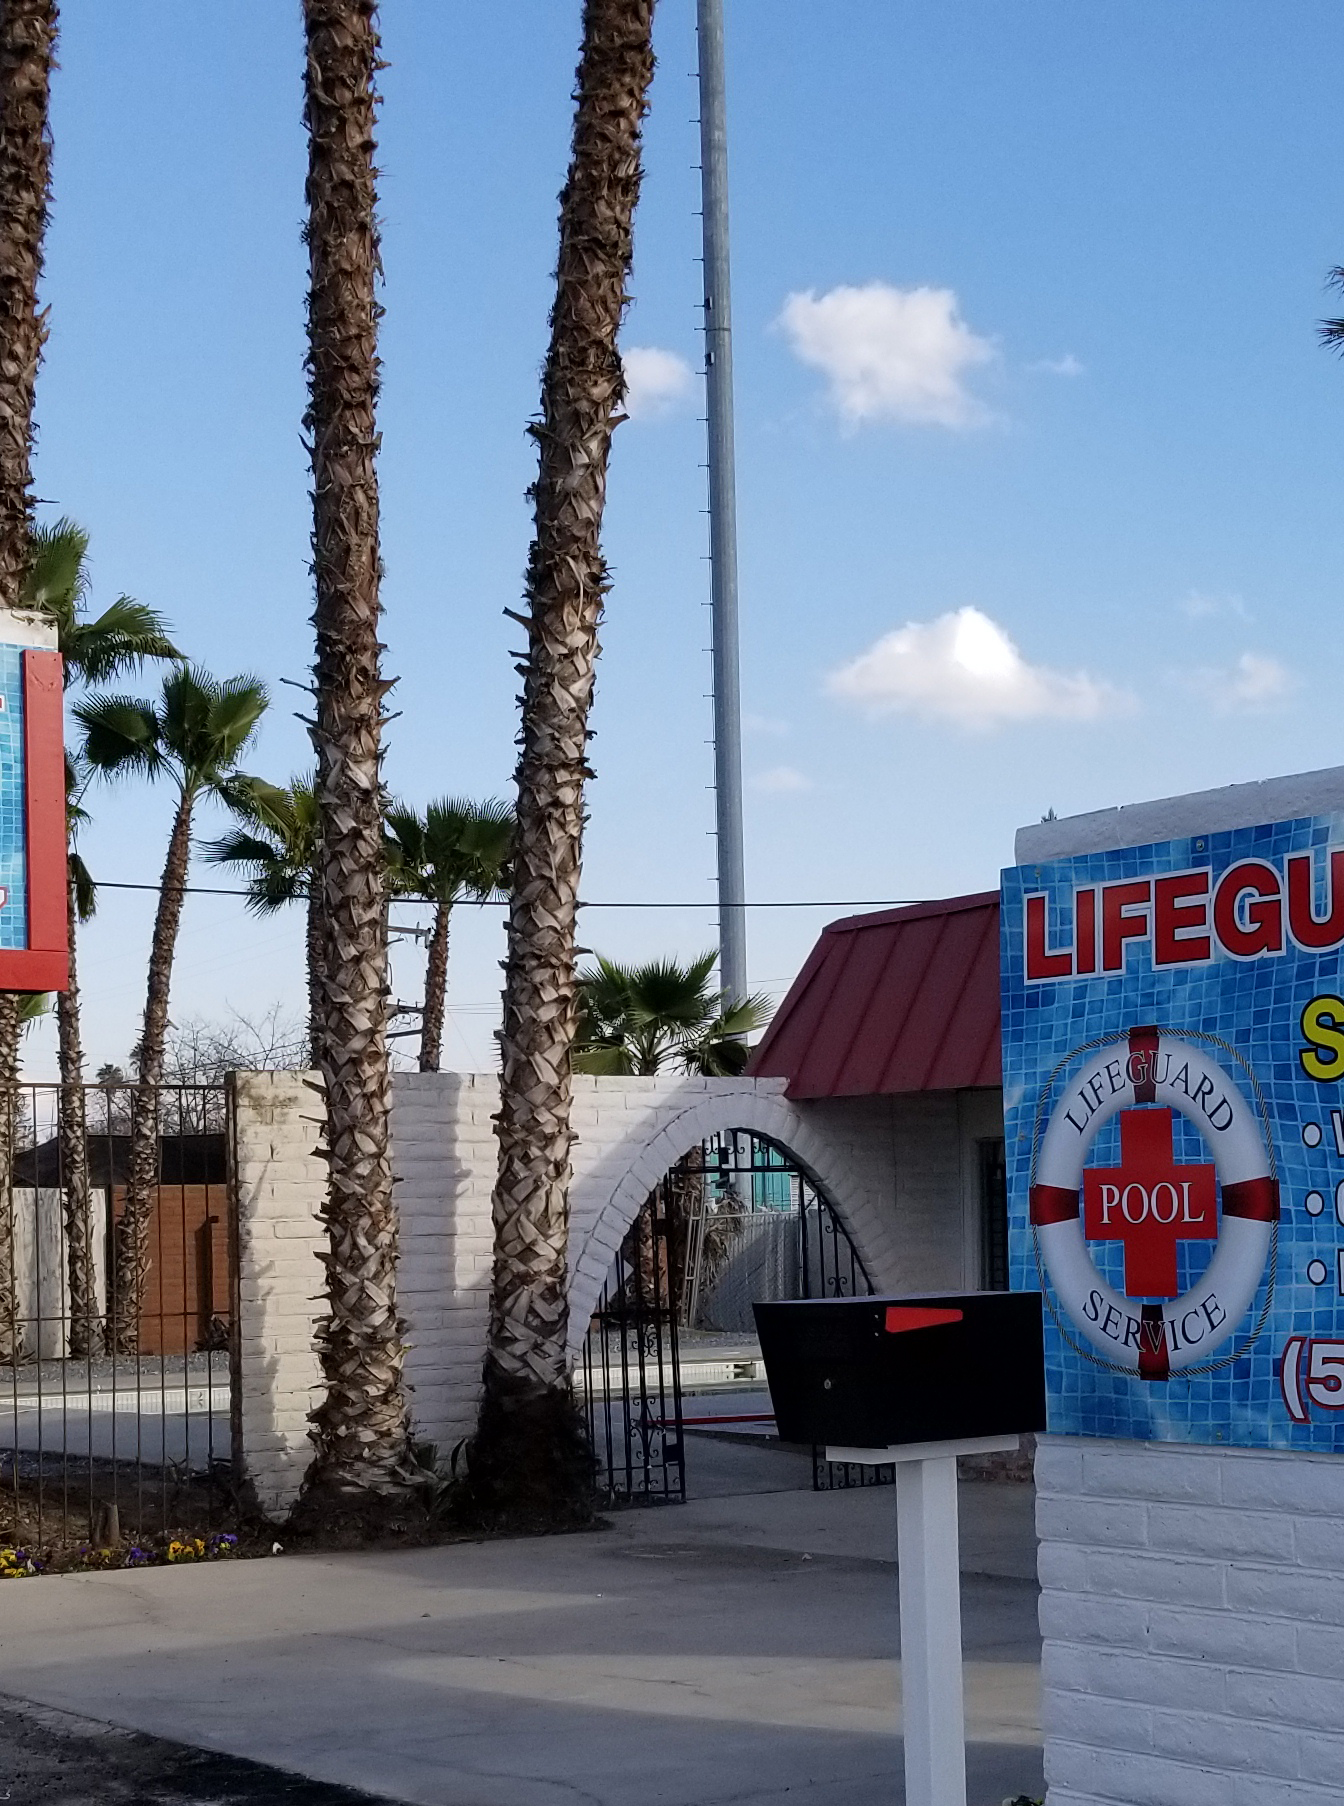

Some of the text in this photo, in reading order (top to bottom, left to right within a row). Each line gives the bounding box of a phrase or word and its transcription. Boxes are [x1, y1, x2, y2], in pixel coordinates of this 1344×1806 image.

[1064, 1050, 1234, 1135] LIFEGUARD
[1099, 1182, 1205, 1224] POOL
[1082, 1289, 1227, 1355] SERVICE
